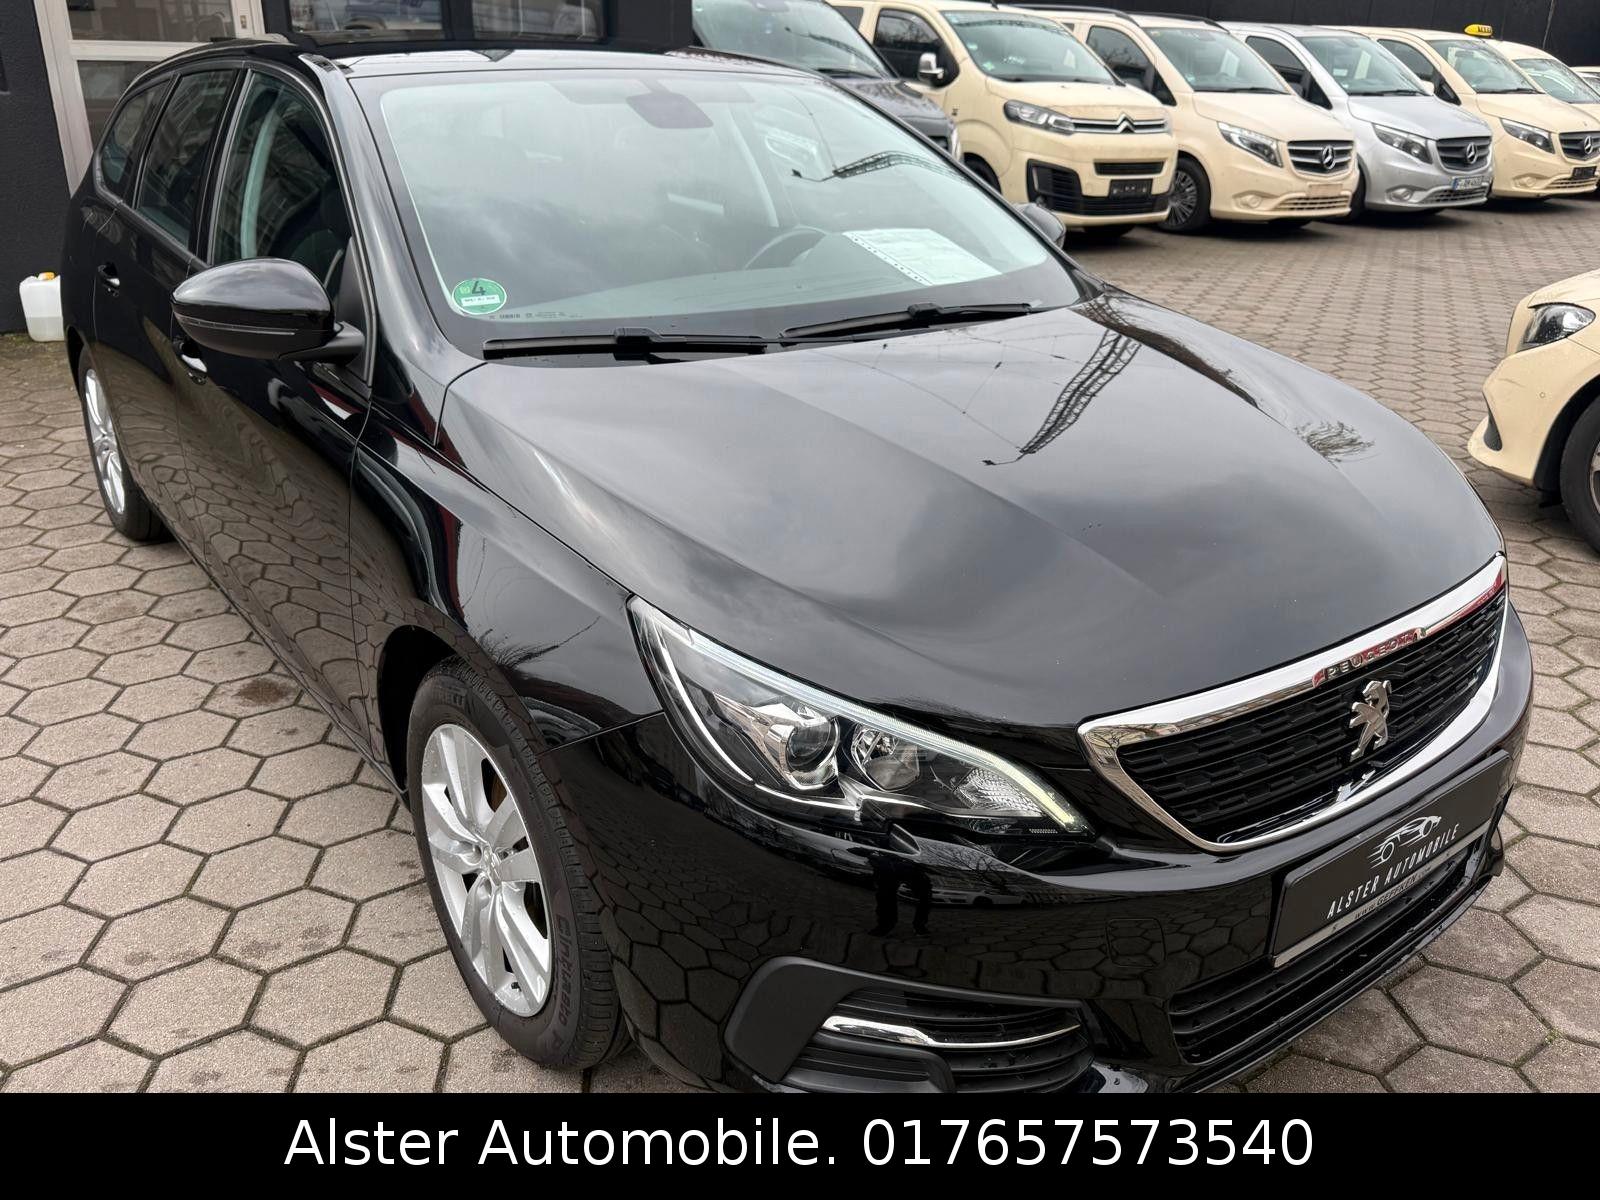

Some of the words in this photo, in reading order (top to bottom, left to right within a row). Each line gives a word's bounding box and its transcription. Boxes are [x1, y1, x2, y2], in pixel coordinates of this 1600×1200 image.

[472, 281, 486, 295] 4
[1327, 633, 1410, 679] PEUGEOT
[1327, 875, 1380, 919] ALSTER
[1385, 823, 1460, 885] AUTOMOBILE
